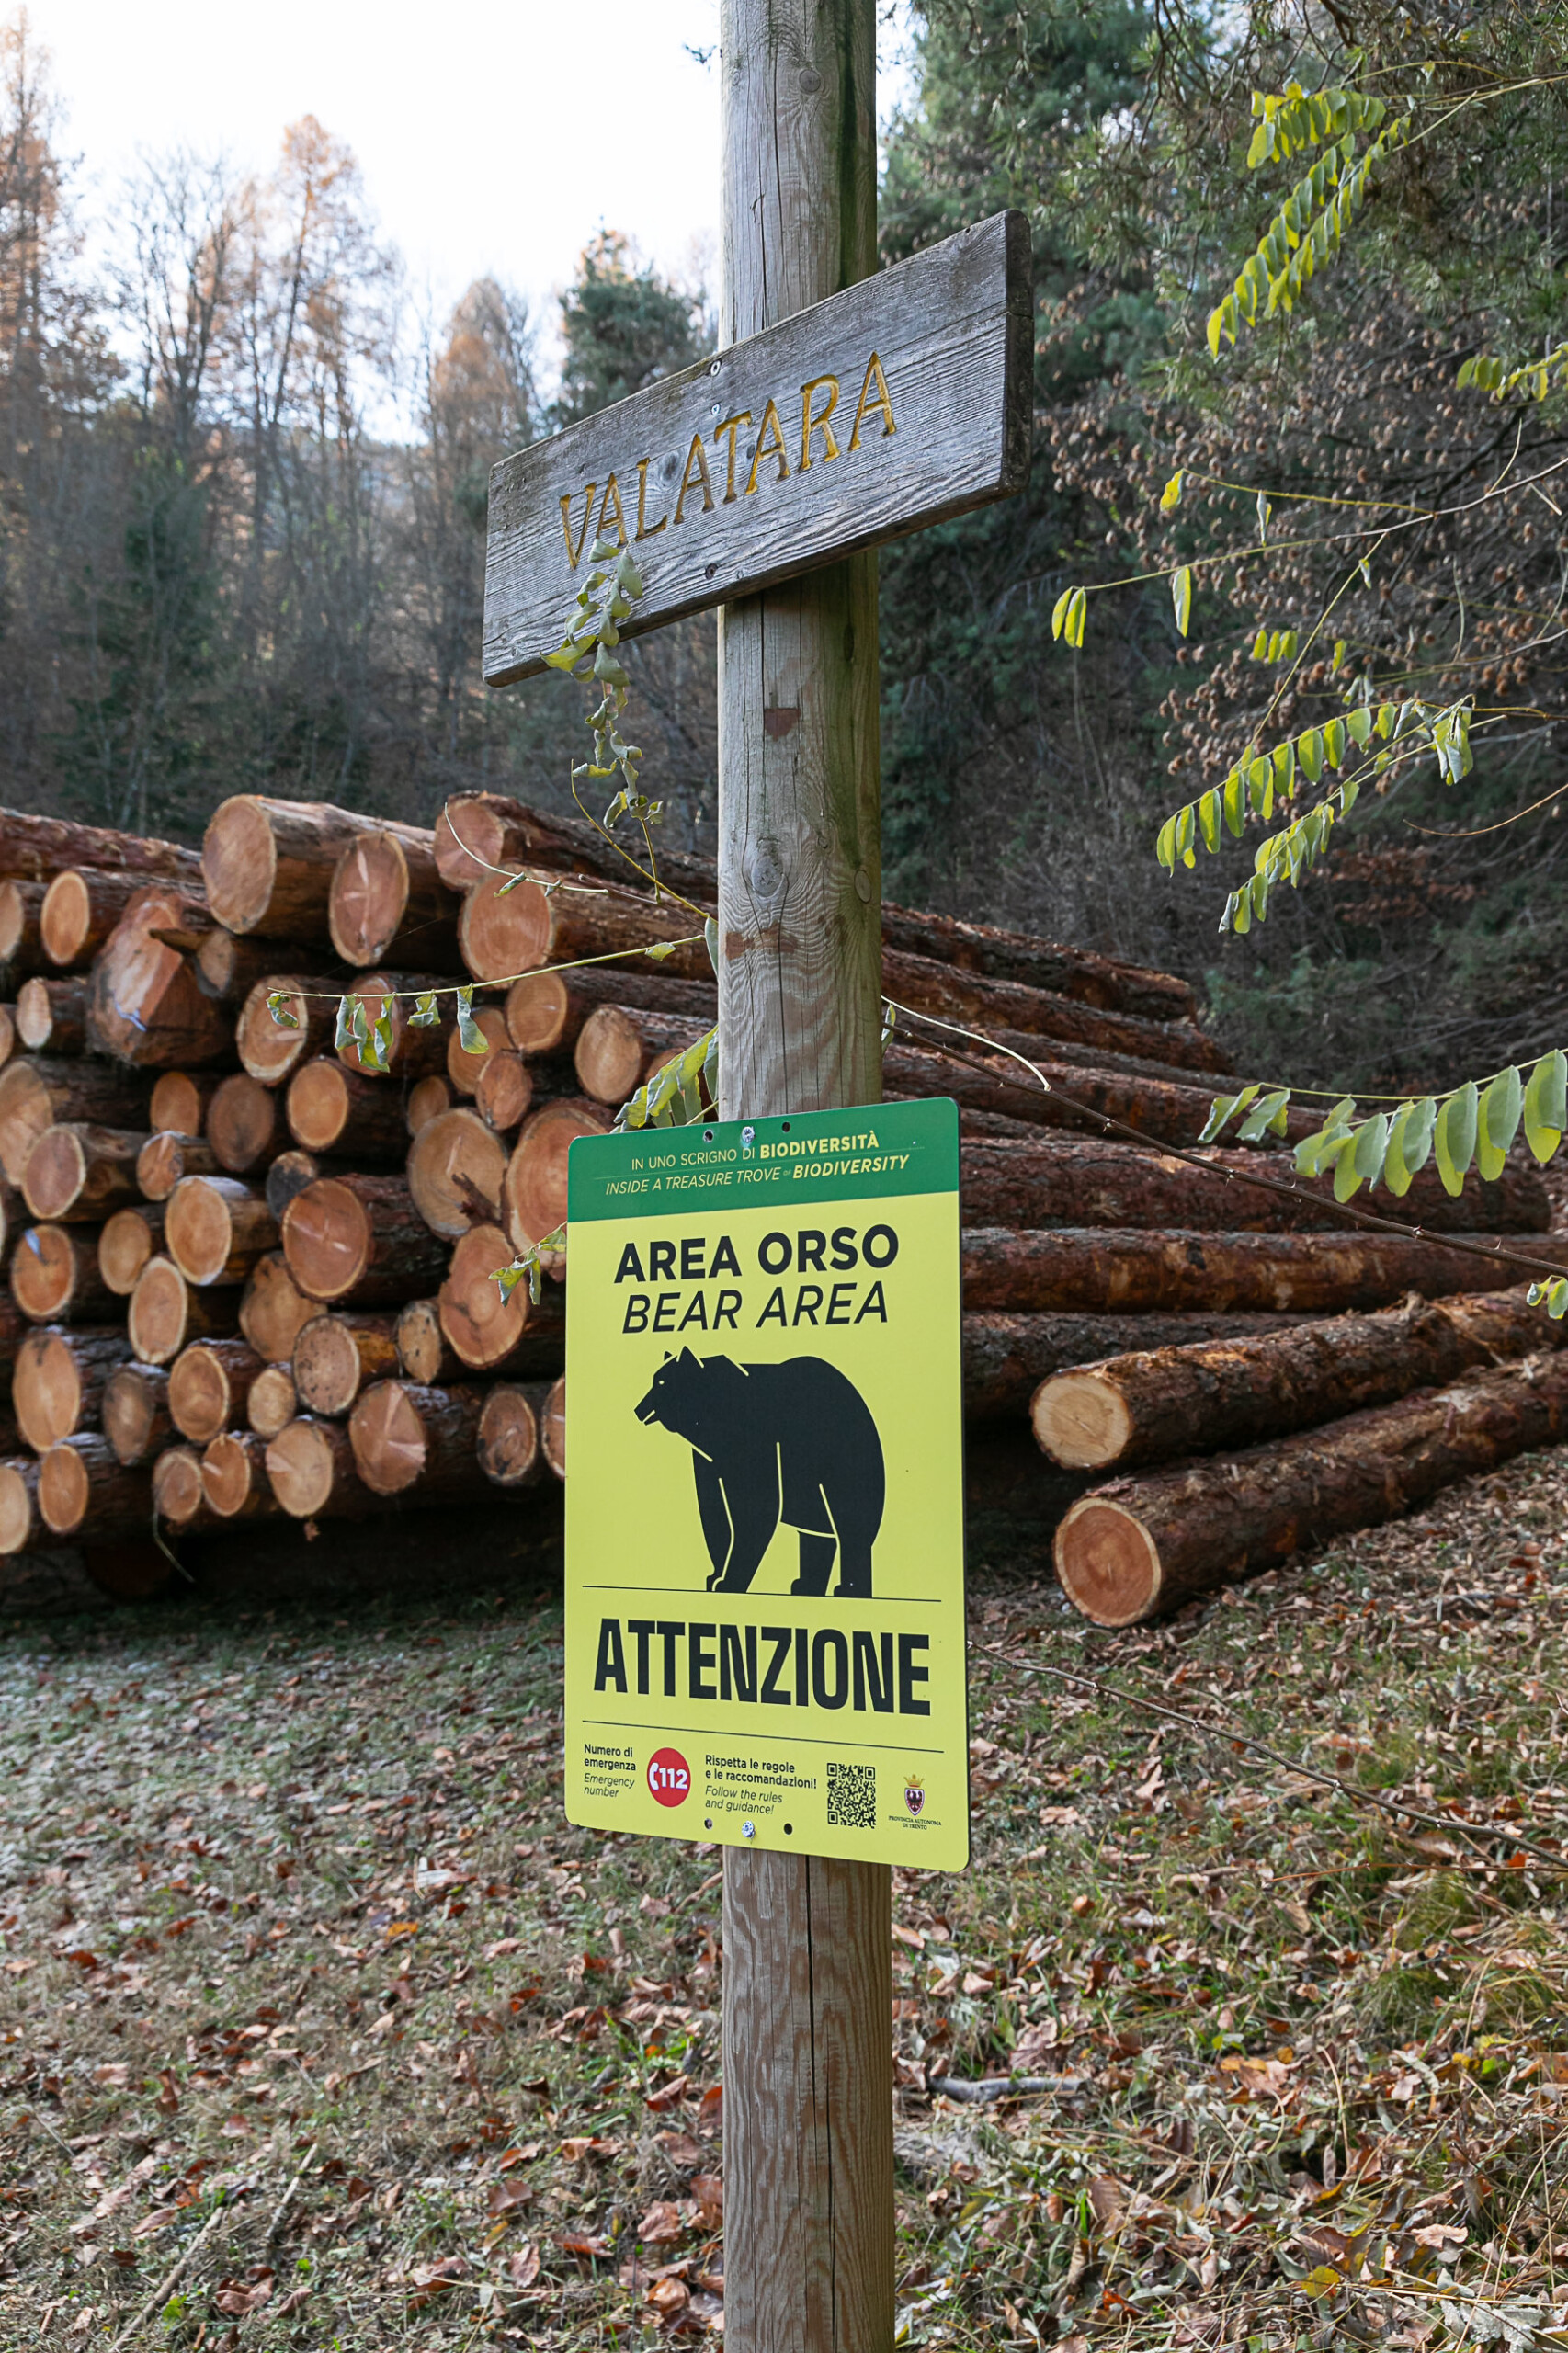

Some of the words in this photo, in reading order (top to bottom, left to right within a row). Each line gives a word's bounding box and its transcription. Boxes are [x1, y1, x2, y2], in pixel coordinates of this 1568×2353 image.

[559, 351, 896, 571] VALATARA
[631, 1158, 643, 1171] IN
[649, 1154, 676, 1168] UNO
[680, 1149, 737, 1165] SCRIGNO
[742, 1147, 755, 1160] DI
[760, 1130, 879, 1159] BIODIVERSITÀ
[606, 1179, 649, 1195] INSIDE
[652, 1178, 662, 1191] A
[665, 1171, 733, 1189] TREASURE
[736, 1166, 781, 1183] TROVE
[792, 1154, 910, 1179] BIODIVERSITY
[614, 1235, 743, 1284] AREA
[757, 1223, 899, 1275] ORSO
[622, 1289, 743, 1334] BEAR
[756, 1280, 888, 1329] AREA
[594, 1618, 931, 1716] ATTENZIONE
[584, 1744, 621, 1756] Numero
[624, 1747, 633, 1757] di
[584, 1758, 636, 1771] emergenza
[705, 1755, 746, 1768] Rispetta
[750, 1758, 758, 1769] le
[762, 1761, 795, 1773] regole
[584, 1773, 635, 1789] Emergency
[659, 1768, 688, 1790] 112
[705, 1770, 711, 1779] e
[714, 1768, 722, 1779] le
[726, 1772, 817, 1789] raccomandazioni!
[584, 1787, 619, 1798] number
[705, 1785, 738, 1798] Follow
[740, 1789, 756, 1801] the
[759, 1791, 783, 1802] rules
[705, 1799, 724, 1809] and
[726, 1802, 774, 1814] guidance!
